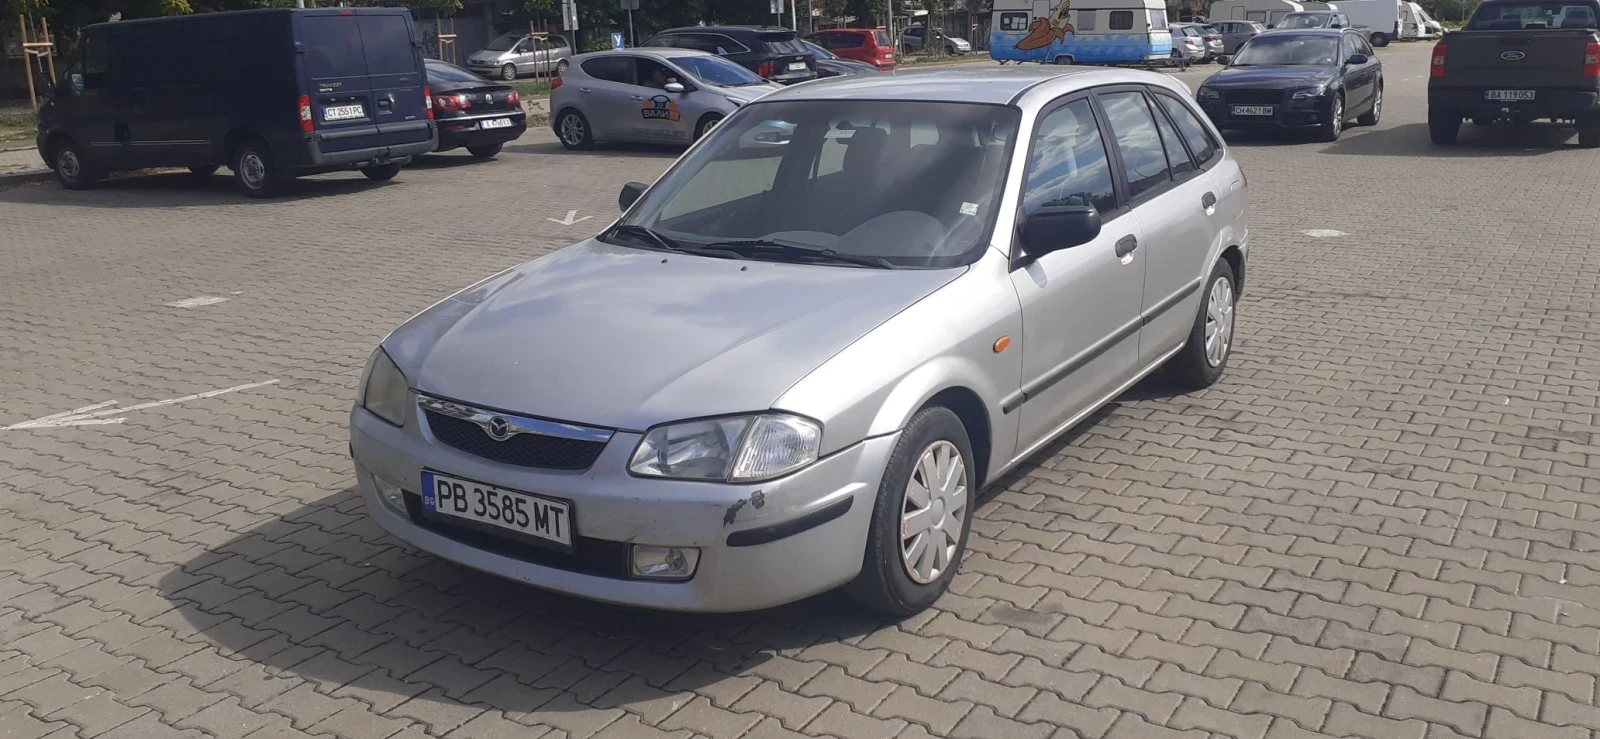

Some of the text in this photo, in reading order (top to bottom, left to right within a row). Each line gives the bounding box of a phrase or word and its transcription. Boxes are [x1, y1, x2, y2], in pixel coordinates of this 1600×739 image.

[1491, 91, 1501, 99] BA
[327, 108, 336, 117] CT
[336, 107, 353, 116] 2551
[352, 106, 362, 115] PC
[643, 109, 669, 118] ВАЛИ
[424, 495, 435, 506] BG
[437, 479, 564, 538] PB 3585 MT
